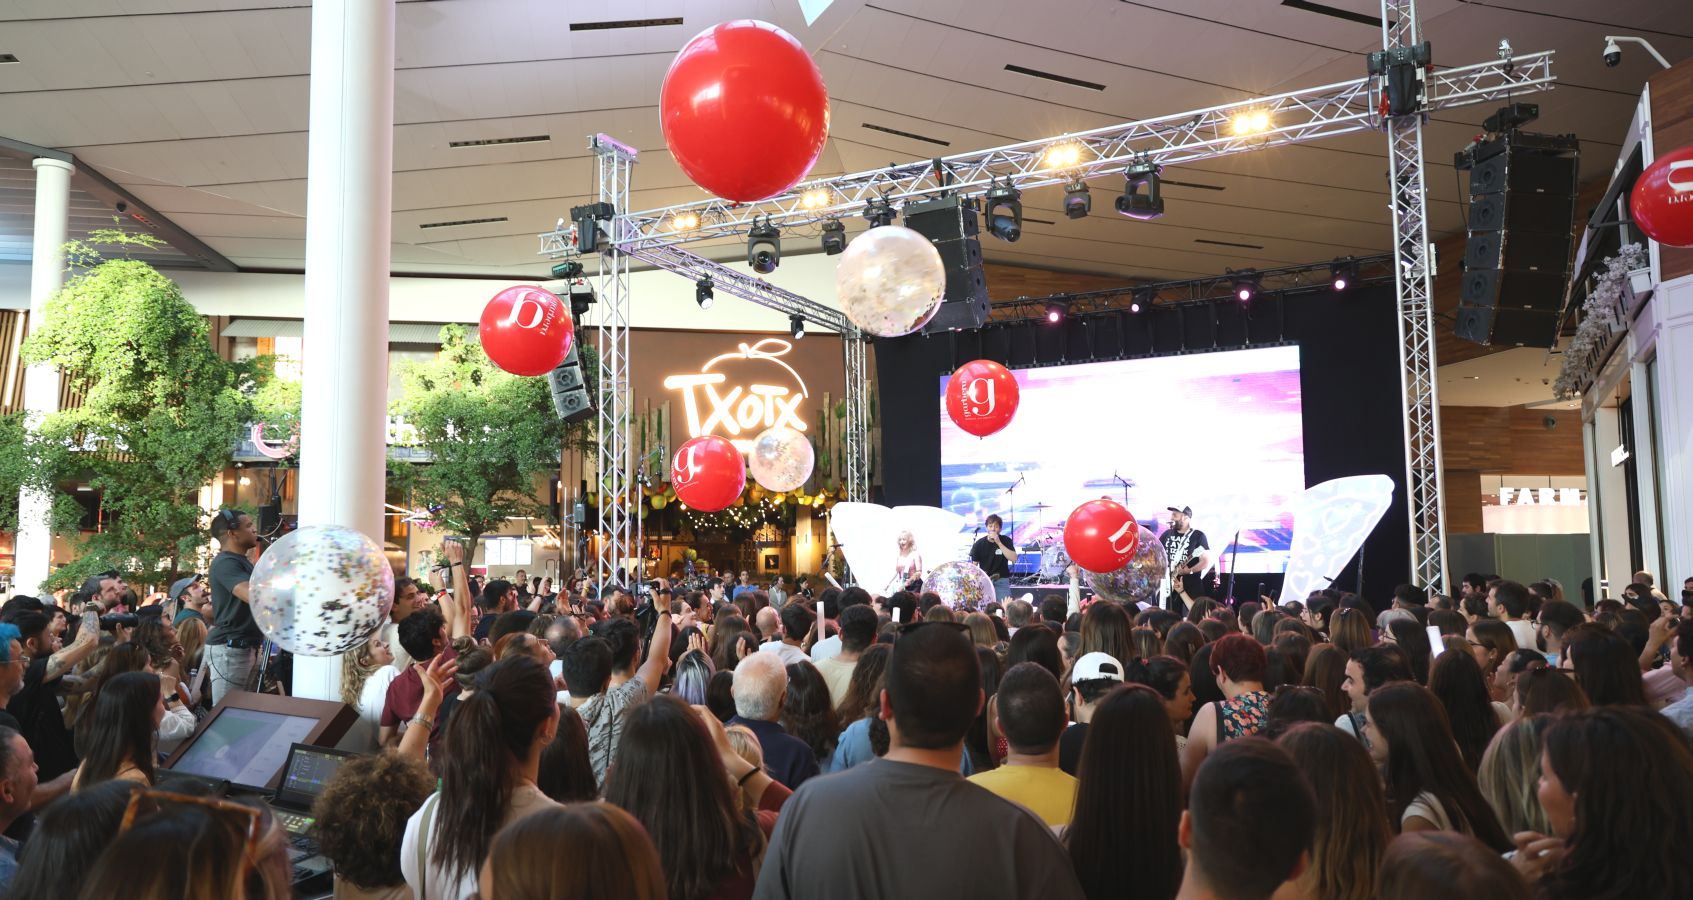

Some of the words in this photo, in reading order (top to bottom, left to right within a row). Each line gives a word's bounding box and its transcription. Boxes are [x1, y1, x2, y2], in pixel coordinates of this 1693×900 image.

[960, 380, 972, 418] garbera
[967, 377, 996, 417] g
[673, 445, 698, 484] g
